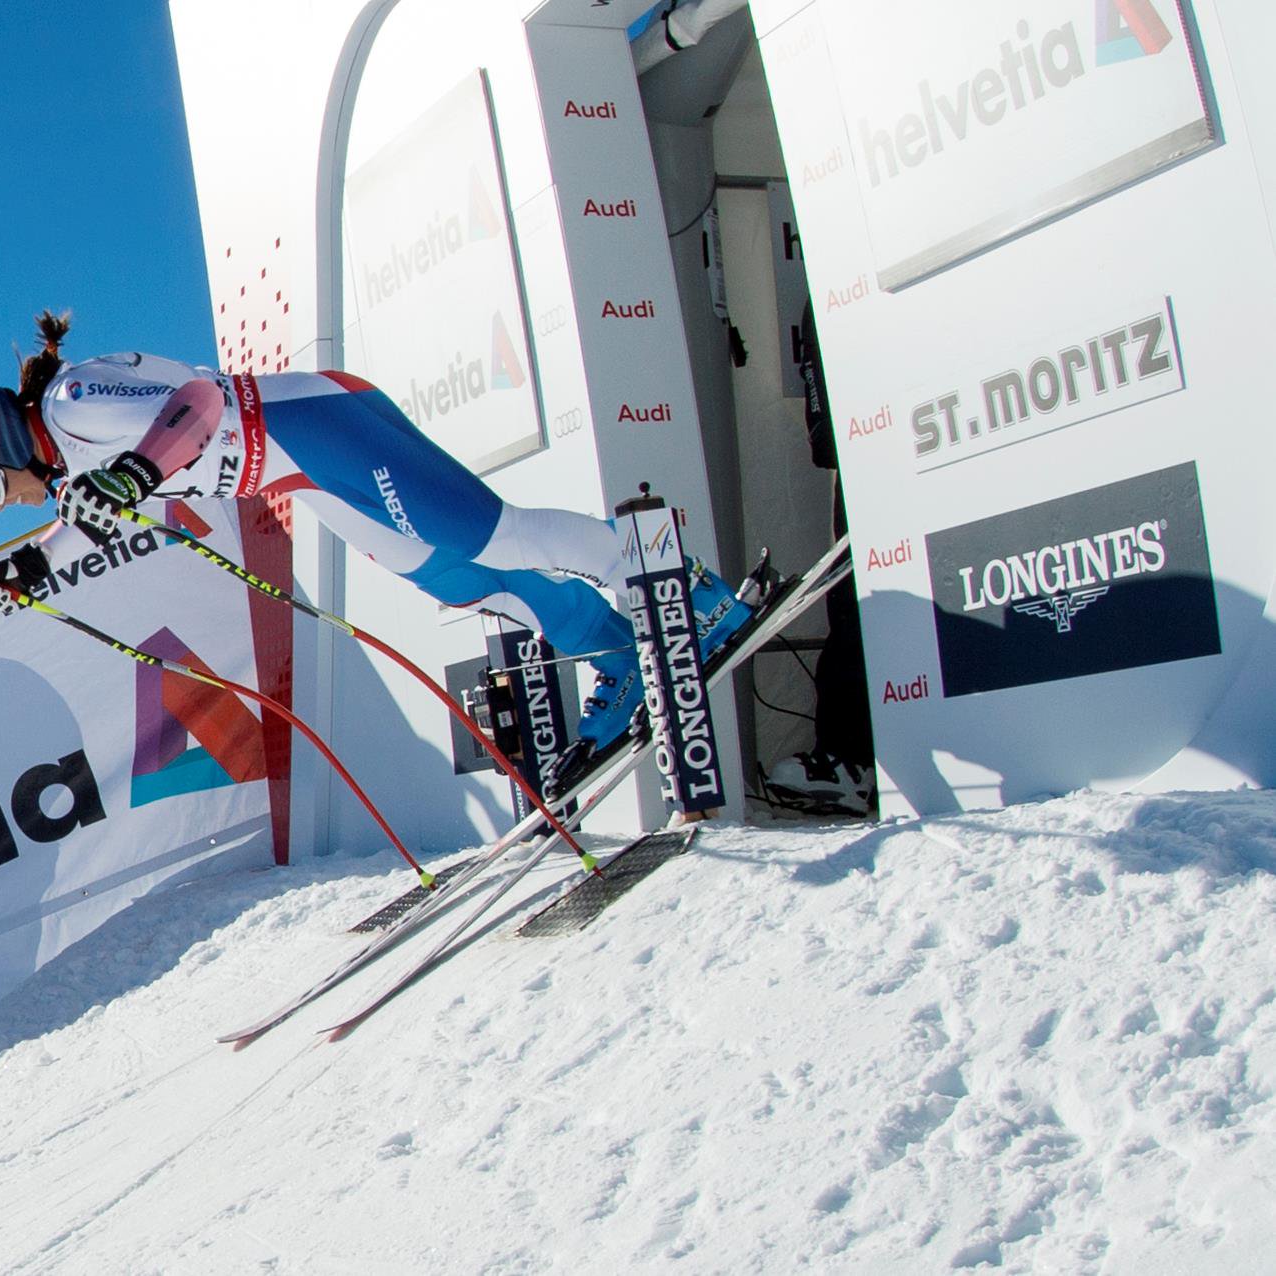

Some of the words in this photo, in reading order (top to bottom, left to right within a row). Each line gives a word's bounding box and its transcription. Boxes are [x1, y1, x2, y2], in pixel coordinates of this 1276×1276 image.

[563, 100, 618, 119] Audi
[857, 18, 1086, 188] helvetia
[801, 147, 844, 188] Audi
[582, 199, 638, 218] Audi
[363, 209, 463, 308] helvetia
[601, 301, 656, 319] Audi
[825, 274, 870, 312] Audi
[399, 352, 488, 428] elvetia
[617, 404, 673, 423] Audi
[848, 405, 894, 440] Audi
[121, 457, 155, 486] racing
[29, 528, 160, 603] elvetia
[182, 538, 231, 570] LEKI
[234, 566, 282, 597] LEKI
[866, 539, 913, 571] Audi
[960, 520, 1165, 612] LONGINES
[653, 577, 719, 800] LONGINES
[882, 676, 930, 705] Audi
